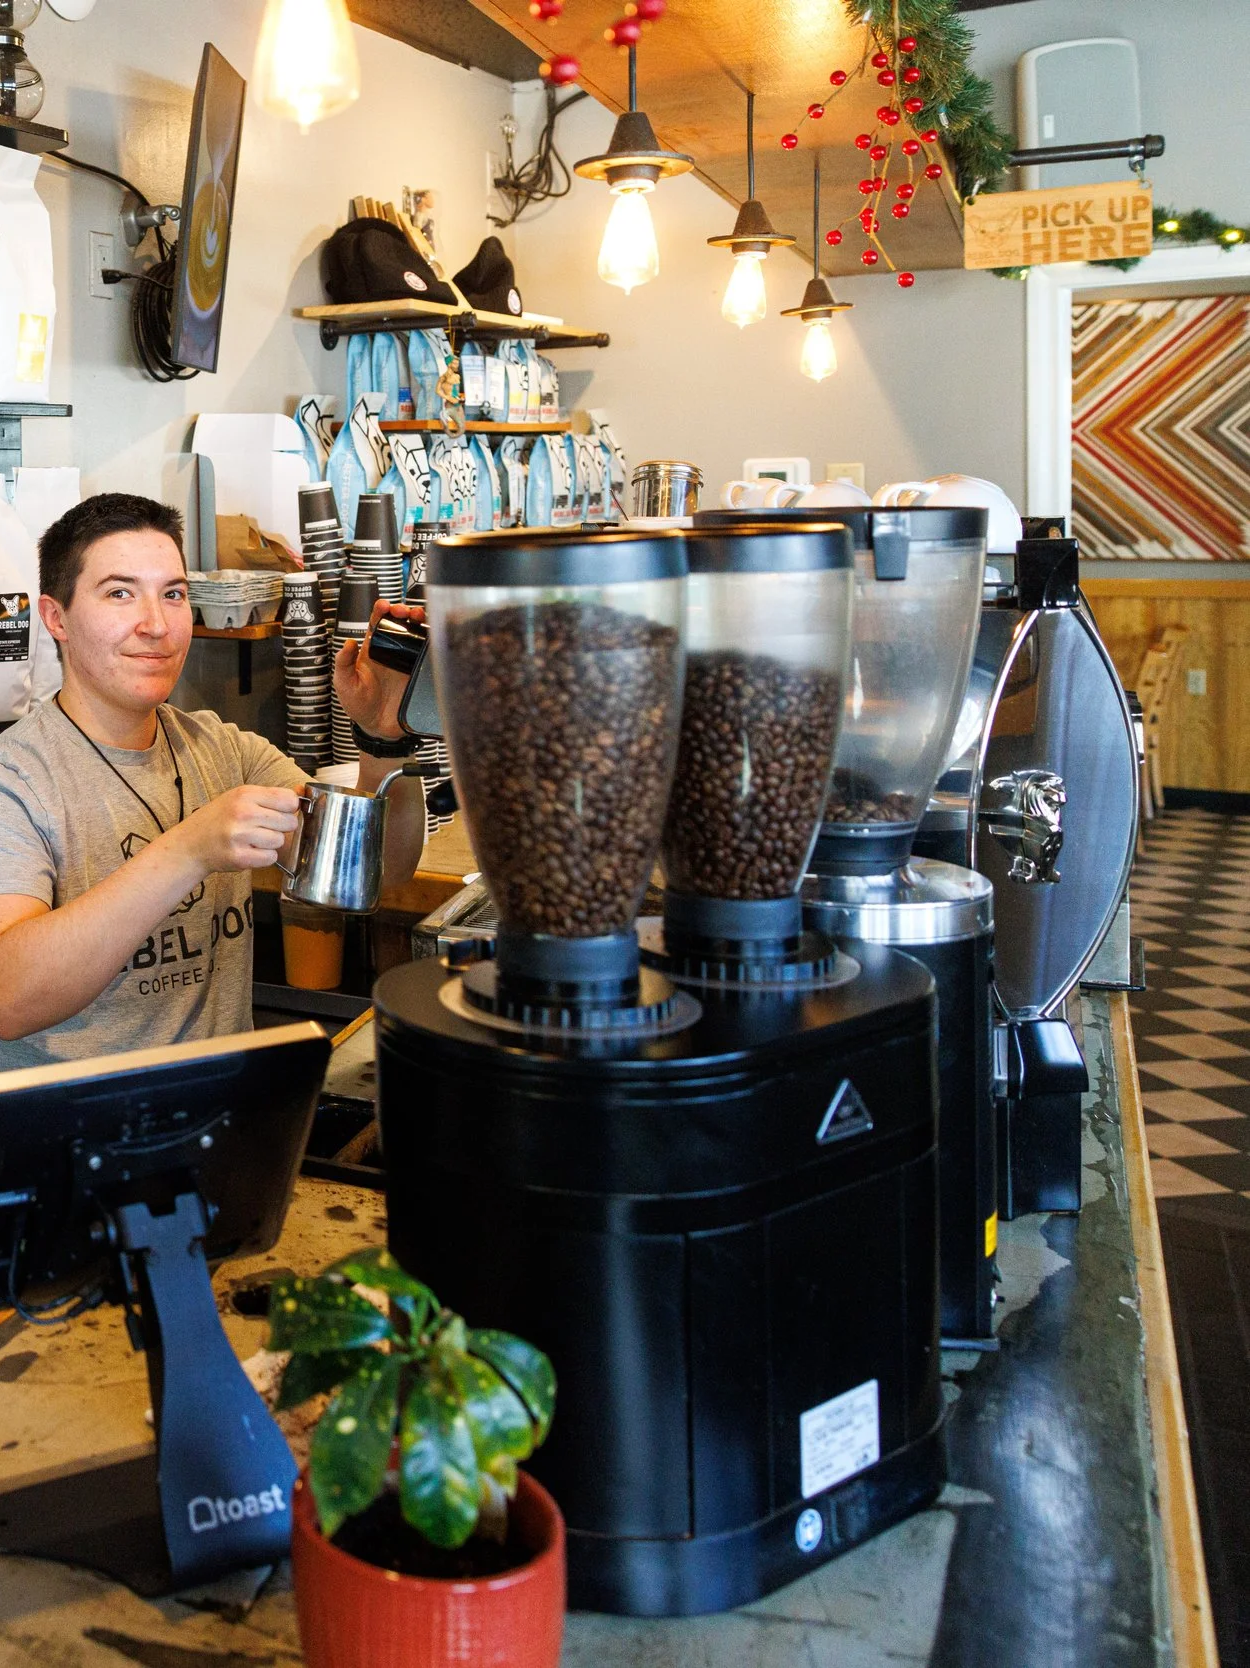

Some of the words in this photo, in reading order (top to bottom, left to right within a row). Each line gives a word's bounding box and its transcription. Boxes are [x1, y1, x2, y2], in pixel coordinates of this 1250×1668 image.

[1022, 200, 1094, 230] PICK
[1108, 195, 1150, 223] UP
[1022, 222, 1149, 264] HERE
[418, 533, 447, 541] COFFEE
[18, 620, 29, 629] DOG
[139, 967, 204, 995] COFFEE
[215, 1483, 286, 1524] toast
